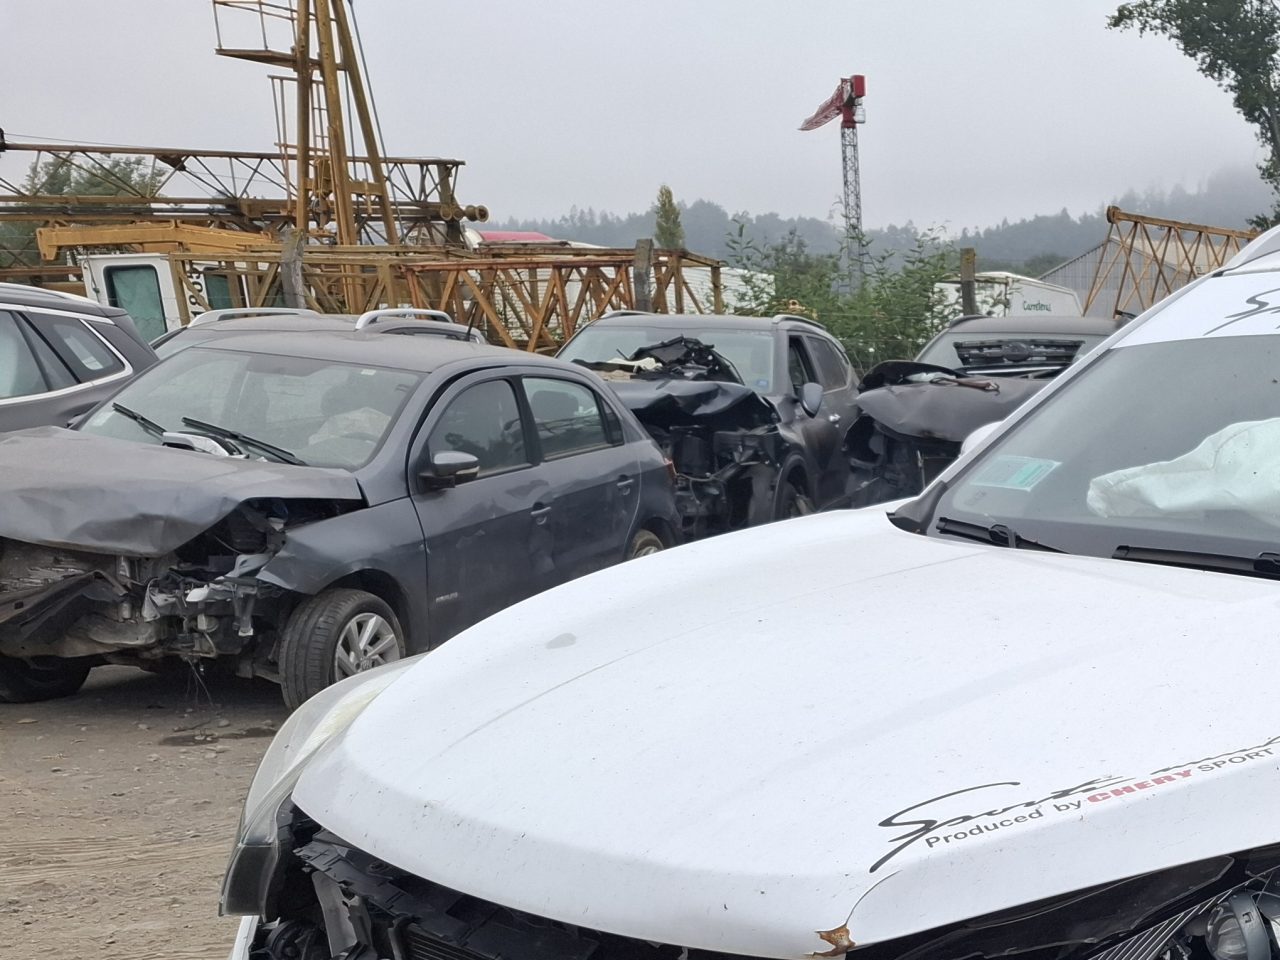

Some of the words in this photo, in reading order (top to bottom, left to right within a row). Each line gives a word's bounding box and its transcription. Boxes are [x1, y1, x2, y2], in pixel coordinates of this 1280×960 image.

[924, 808, 1044, 849] Produced
[1052, 799, 1082, 812] by
[1086, 768, 1193, 803] CHERY
[1196, 747, 1275, 772] SPORT
